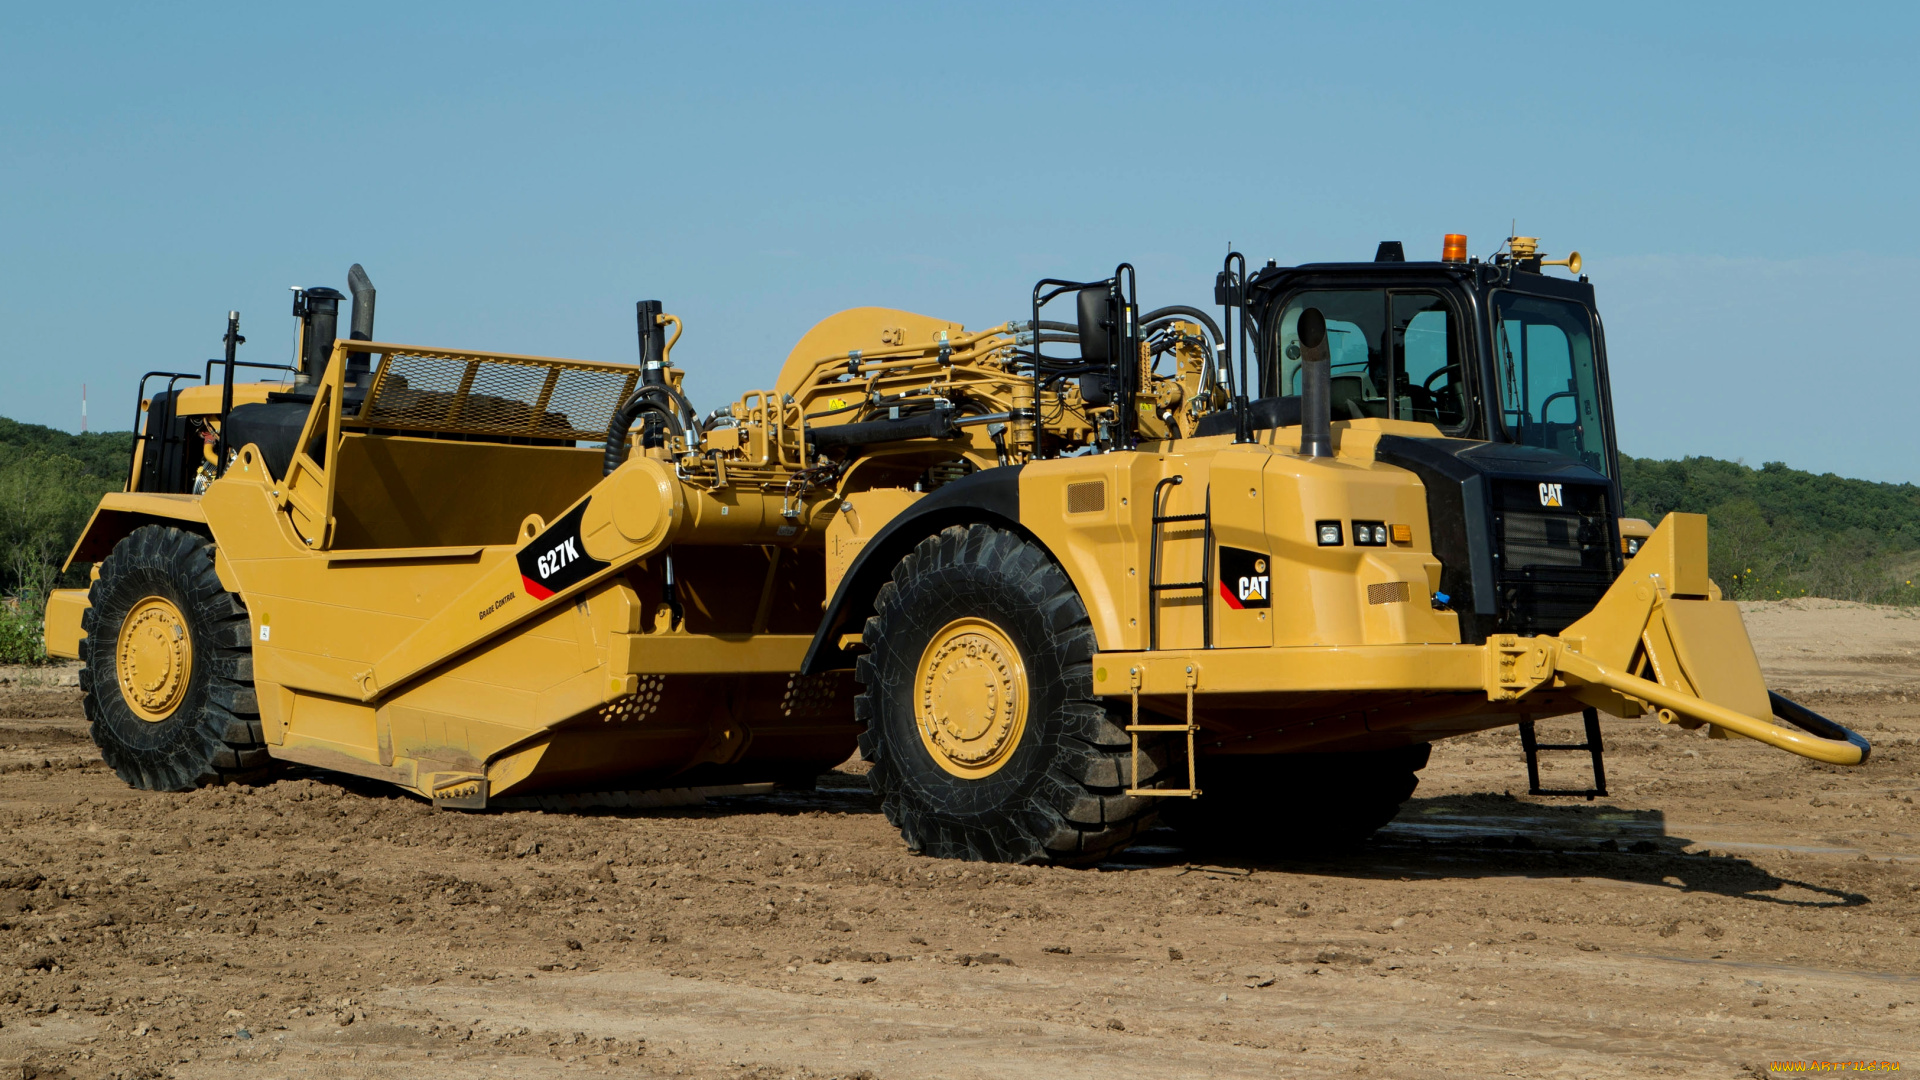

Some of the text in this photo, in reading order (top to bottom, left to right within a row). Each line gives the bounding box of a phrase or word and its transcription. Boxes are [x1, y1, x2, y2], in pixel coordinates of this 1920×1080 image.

[1539, 483, 1562, 506] CAT
[537, 536, 579, 579] 627K
[1239, 576, 1269, 600] CAT
